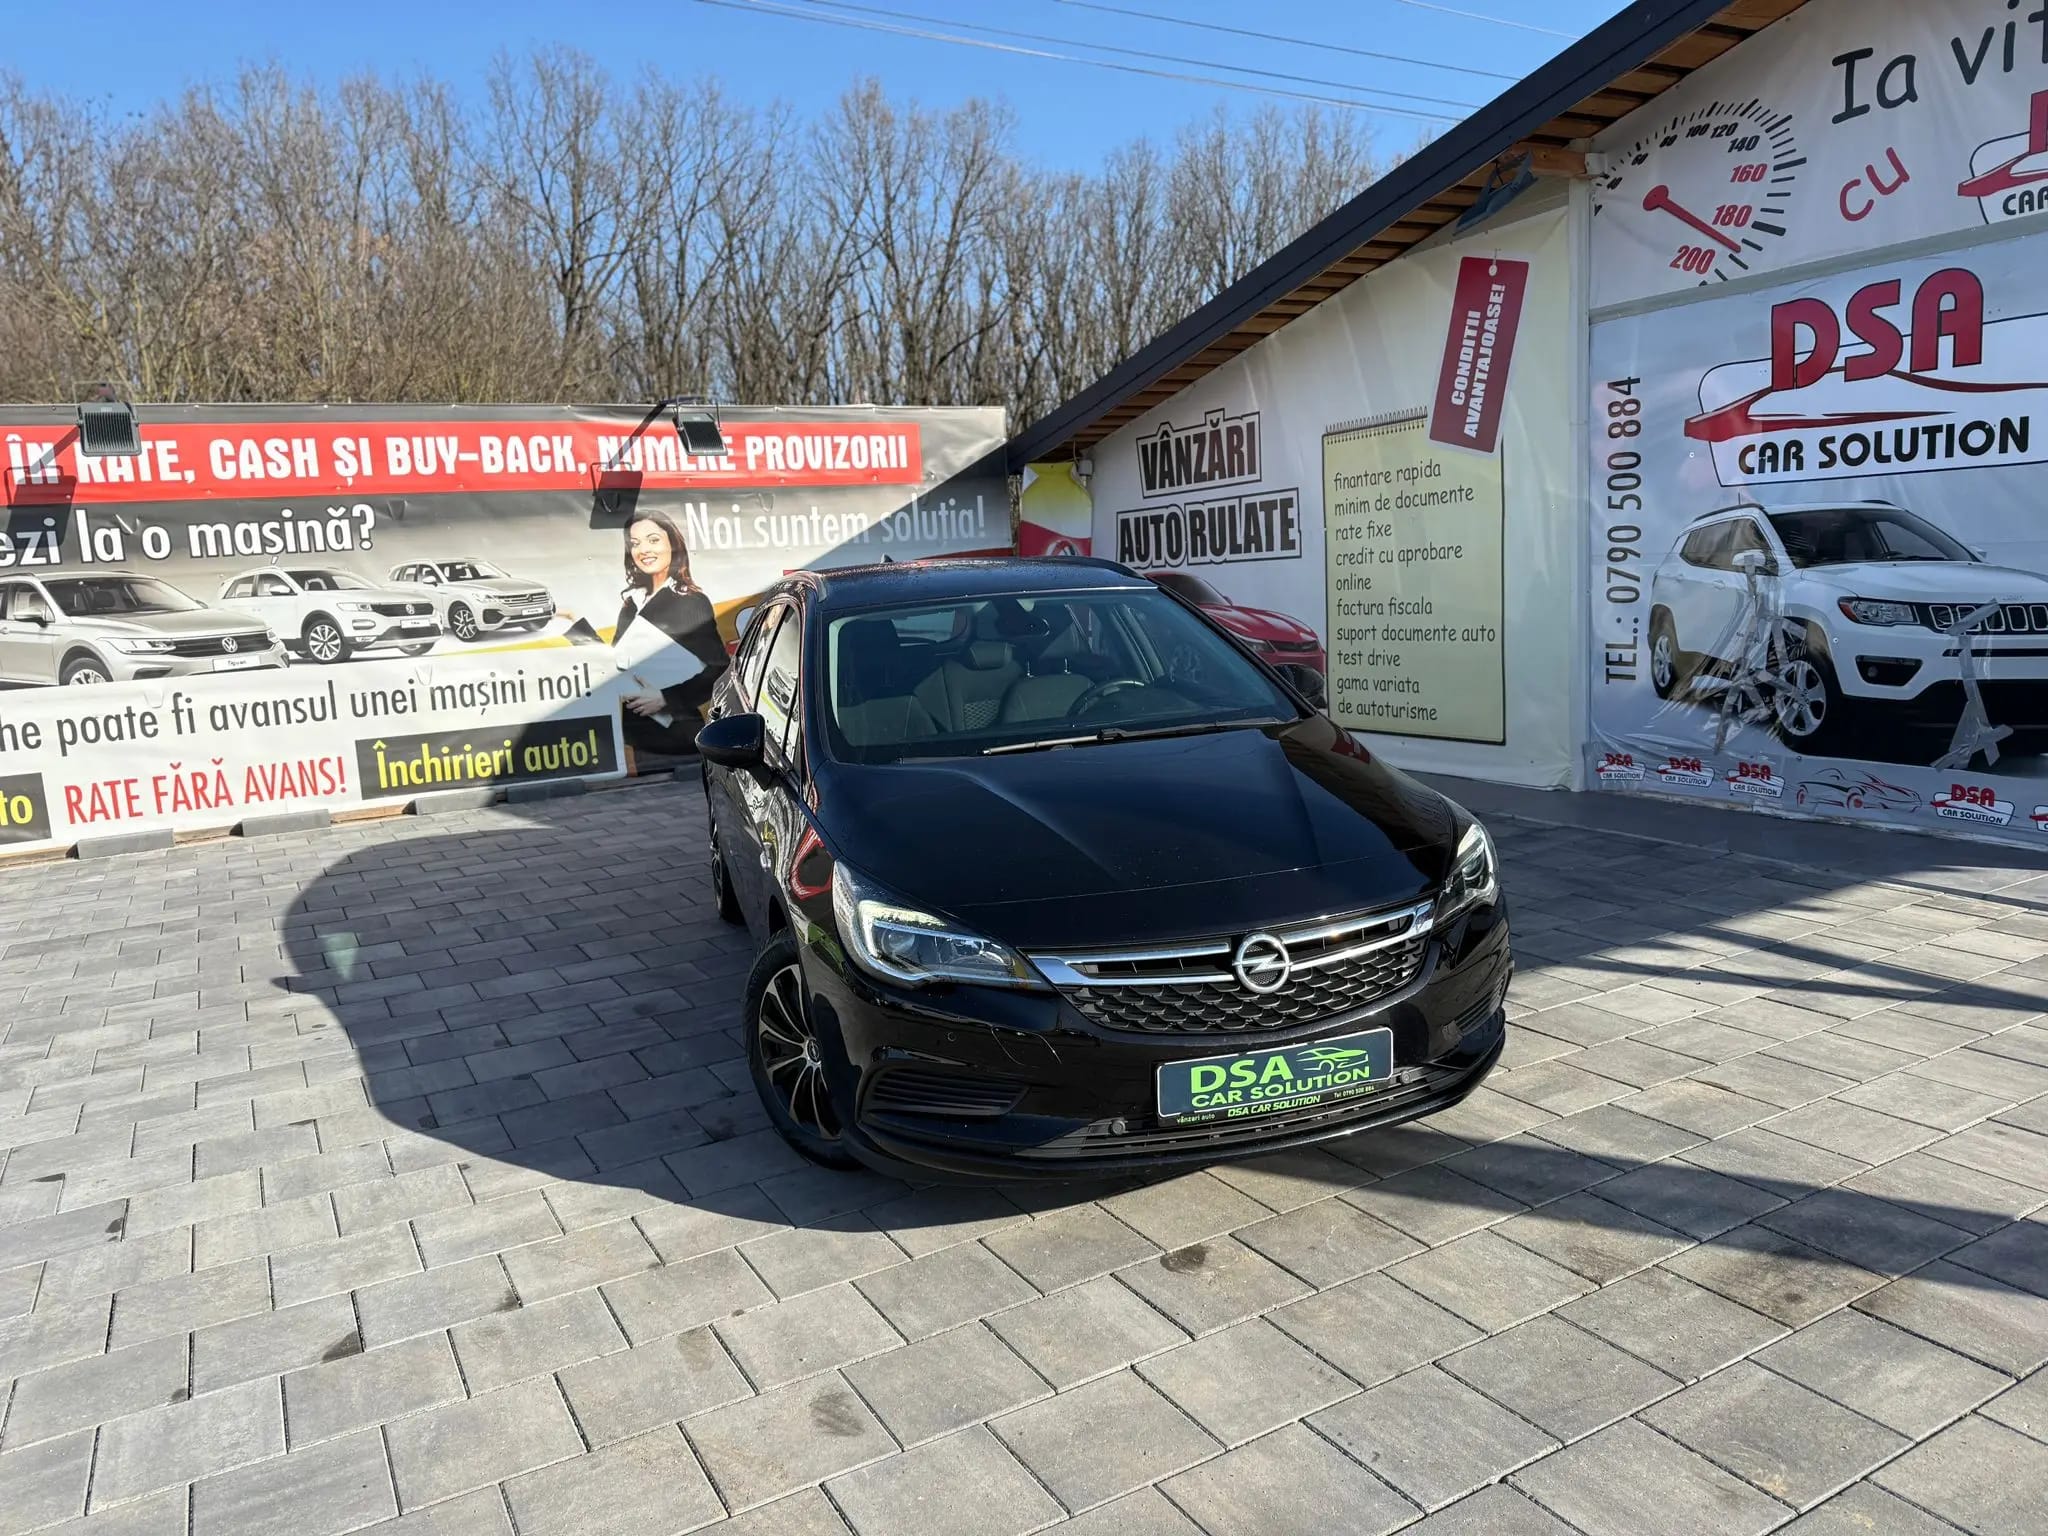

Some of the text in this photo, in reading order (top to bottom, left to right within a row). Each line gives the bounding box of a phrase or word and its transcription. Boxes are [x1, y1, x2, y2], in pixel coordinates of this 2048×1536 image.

[1831, 47, 1918, 124] Ia
[1685, 121, 1739, 139] 100 120
[1727, 134, 1761, 153] 140
[1729, 162, 1768, 183] 160
[1839, 146, 1910, 222] cu
[1711, 204, 1753, 228] 180
[1669, 244, 1716, 275] 200
[1771, 267, 1984, 392] DSA
[1451, 310, 1481, 406] CONDITII
[1463, 283, 1506, 439] AVANTAJOASE!
[1140, 417, 1257, 491] VÂNZĂRI
[1738, 415, 2030, 475] CAR SOLUTION
[5, 433, 60, 485] ÎN
[209, 438, 319, 480] CASH
[333, 437, 373, 485] ȘI
[747, 435, 908, 471] PROVIZORII
[1334, 458, 1441, 491] finantare rapida
[1335, 485, 1474, 516] minim de documente
[684, 493, 986, 551] Noi suntem soluția!
[1335, 520, 1392, 541] rate fixe
[1605, 376, 1642, 685] TEL.: 0790 500 884
[0, 503, 375, 568] ezi la o mașină?
[1335, 541, 1463, 567] credit cu aprobare
[1335, 574, 1372, 591] online
[1336, 596, 1433, 616] factura fiscala
[1336, 624, 1496, 646] suport documente auto
[1337, 648, 1401, 667] test drive
[1336, 676, 1420, 694] gama variata
[56, 705, 159, 757] poate
[172, 691, 197, 735] fi
[209, 679, 338, 731] avansul
[350, 678, 418, 718] unei
[430, 669, 527, 716] mașini
[538, 662, 593, 701] noi!
[1337, 698, 1438, 721] de autoturisme
[372, 728, 600, 790] Închirieri auto!
[1605, 752, 1633, 767] DSA
[1668, 756, 1702, 772] DSA
[1738, 761, 1772, 781] DSA
[64, 755, 348, 826] RATE FĂRĂ AVANS!
[1677, 776, 1708, 786] SOLUTION
[1749, 785, 1778, 796] SOLUTION
[1951, 783, 1996, 808] DSA
[1942, 808, 2003, 824] CAR SOLUTION
[1190, 1055, 1295, 1094] DSA
[1191, 1065, 1370, 1108] CAR SOLUTION
[1227, 1095, 1321, 1118] DSA CAR SOLUTION
